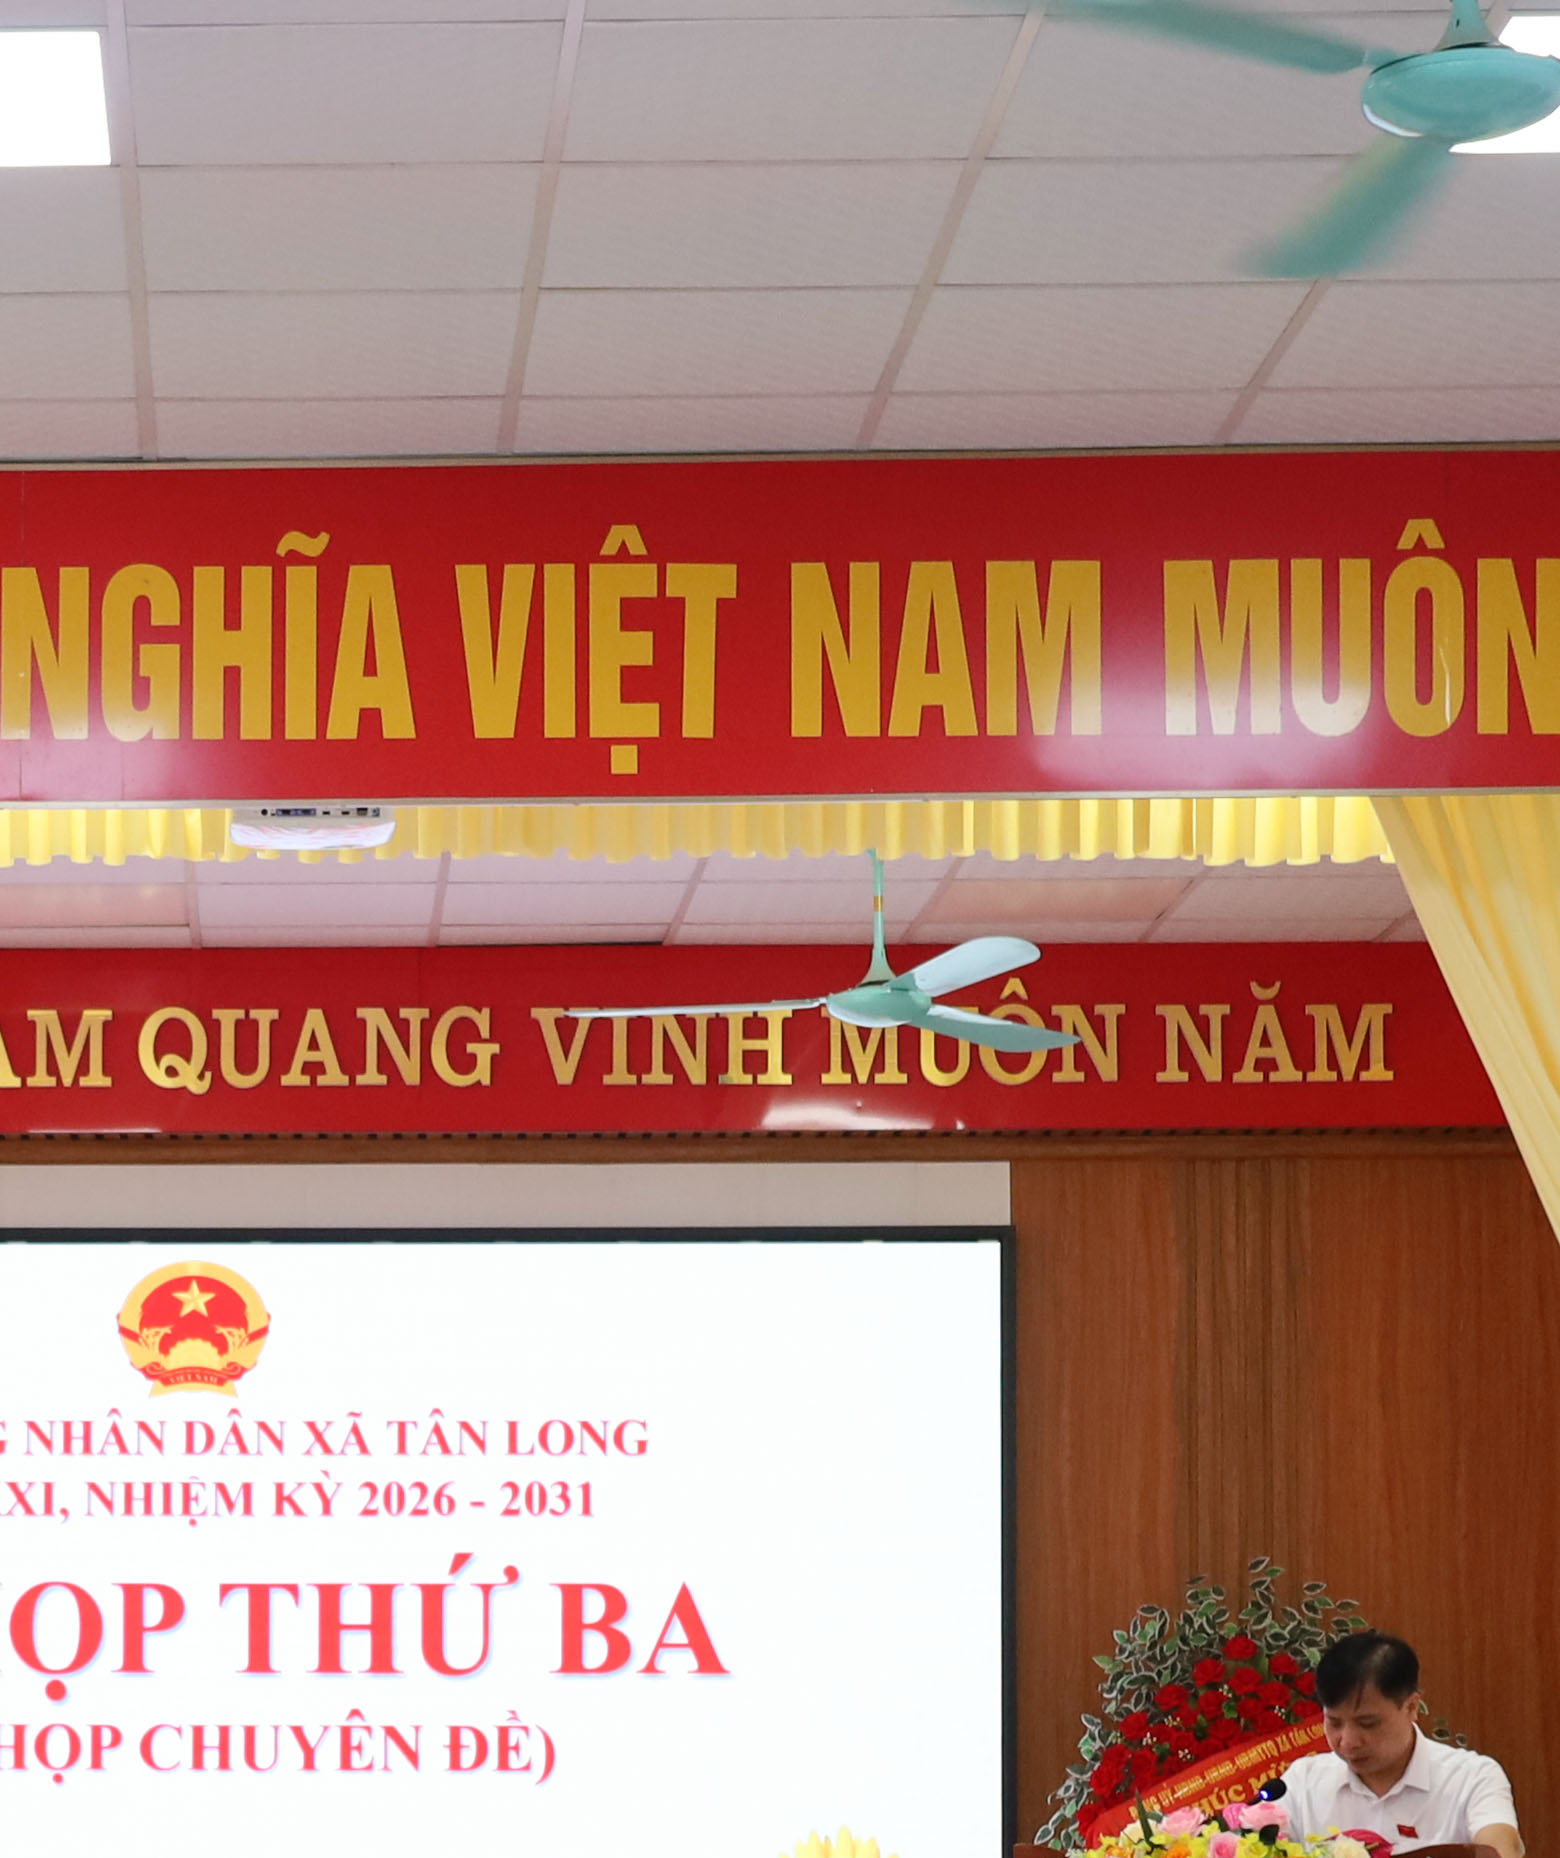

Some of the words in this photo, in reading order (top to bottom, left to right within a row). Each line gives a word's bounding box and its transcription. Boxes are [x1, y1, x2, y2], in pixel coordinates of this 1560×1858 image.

[1, 530, 417, 740] NGHĨA
[455, 525, 737, 774] VIỆT
[791, 560, 1101, 737] NAM
[137, 1005, 501, 1094] QUANG
[531, 1007, 794, 1086] VINH
[820, 977, 1125, 1087] MUÔN
[1157, 983, 1395, 1082] NĂM
[25, 1407, 164, 1456] NHÂN
[184, 1407, 285, 1456] DÂN
[303, 1411, 371, 1457] XÃ
[386, 1407, 487, 1457] TÂN
[506, 1419, 649, 1457] LONG
[87, 1474, 254, 1527] NHIỆM
[273, 1469, 343, 1518] KỲ
[359, 1480, 457, 1518] 2026
[500, 1480, 593, 1518] 2031
[219, 1551, 521, 1678] THỨ
[551, 1582, 731, 1676] BA
[139, 1707, 422, 1773] CHUYÊN
[444, 1709, 556, 1785] ĐỀ)
